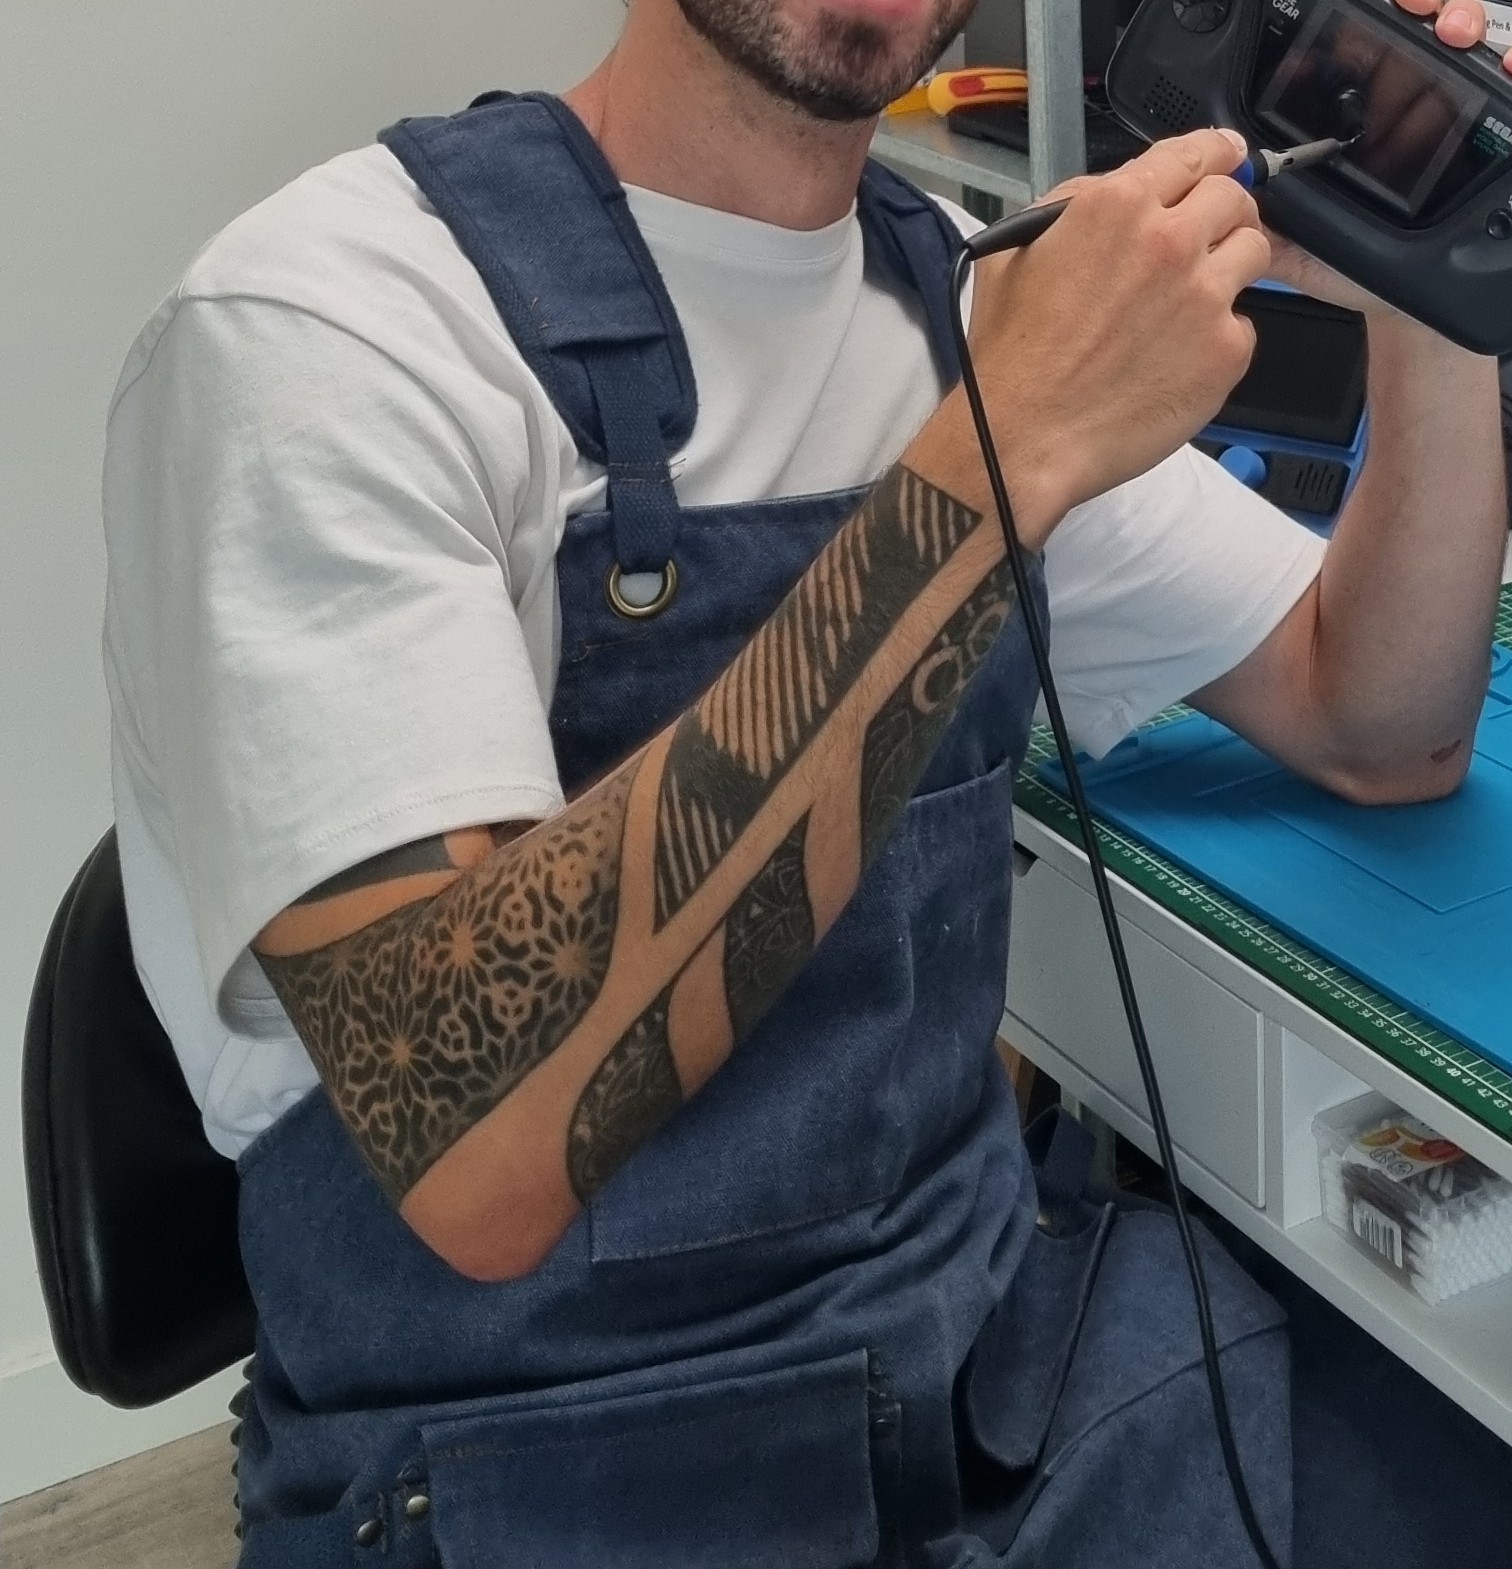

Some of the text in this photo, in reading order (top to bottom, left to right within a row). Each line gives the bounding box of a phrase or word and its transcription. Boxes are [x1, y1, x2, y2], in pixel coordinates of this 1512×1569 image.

[1491, 18, 1504, 31] Pen
[1505, 21, 1512, 32] &
[1303, 972, 1318, 981] 30
[1316, 981, 1330, 990] 31
[1330, 990, 1345, 999] 32
[1344, 1000, 1359, 1009] 33
[1357, 1009, 1373, 1018] 34
[1371, 1018, 1387, 1028] 35
[1386, 1028, 1402, 1037] 36
[1400, 1037, 1417, 1046] 37
[1415, 1047, 1431, 1057] 38
[1430, 1057, 1446, 1067] 39
[1446, 1068, 1461, 1077] 40
[1461, 1078, 1476, 1087] 41
[1477, 1088, 1493, 1098] 42
[1493, 1099, 1509, 1108] 43
